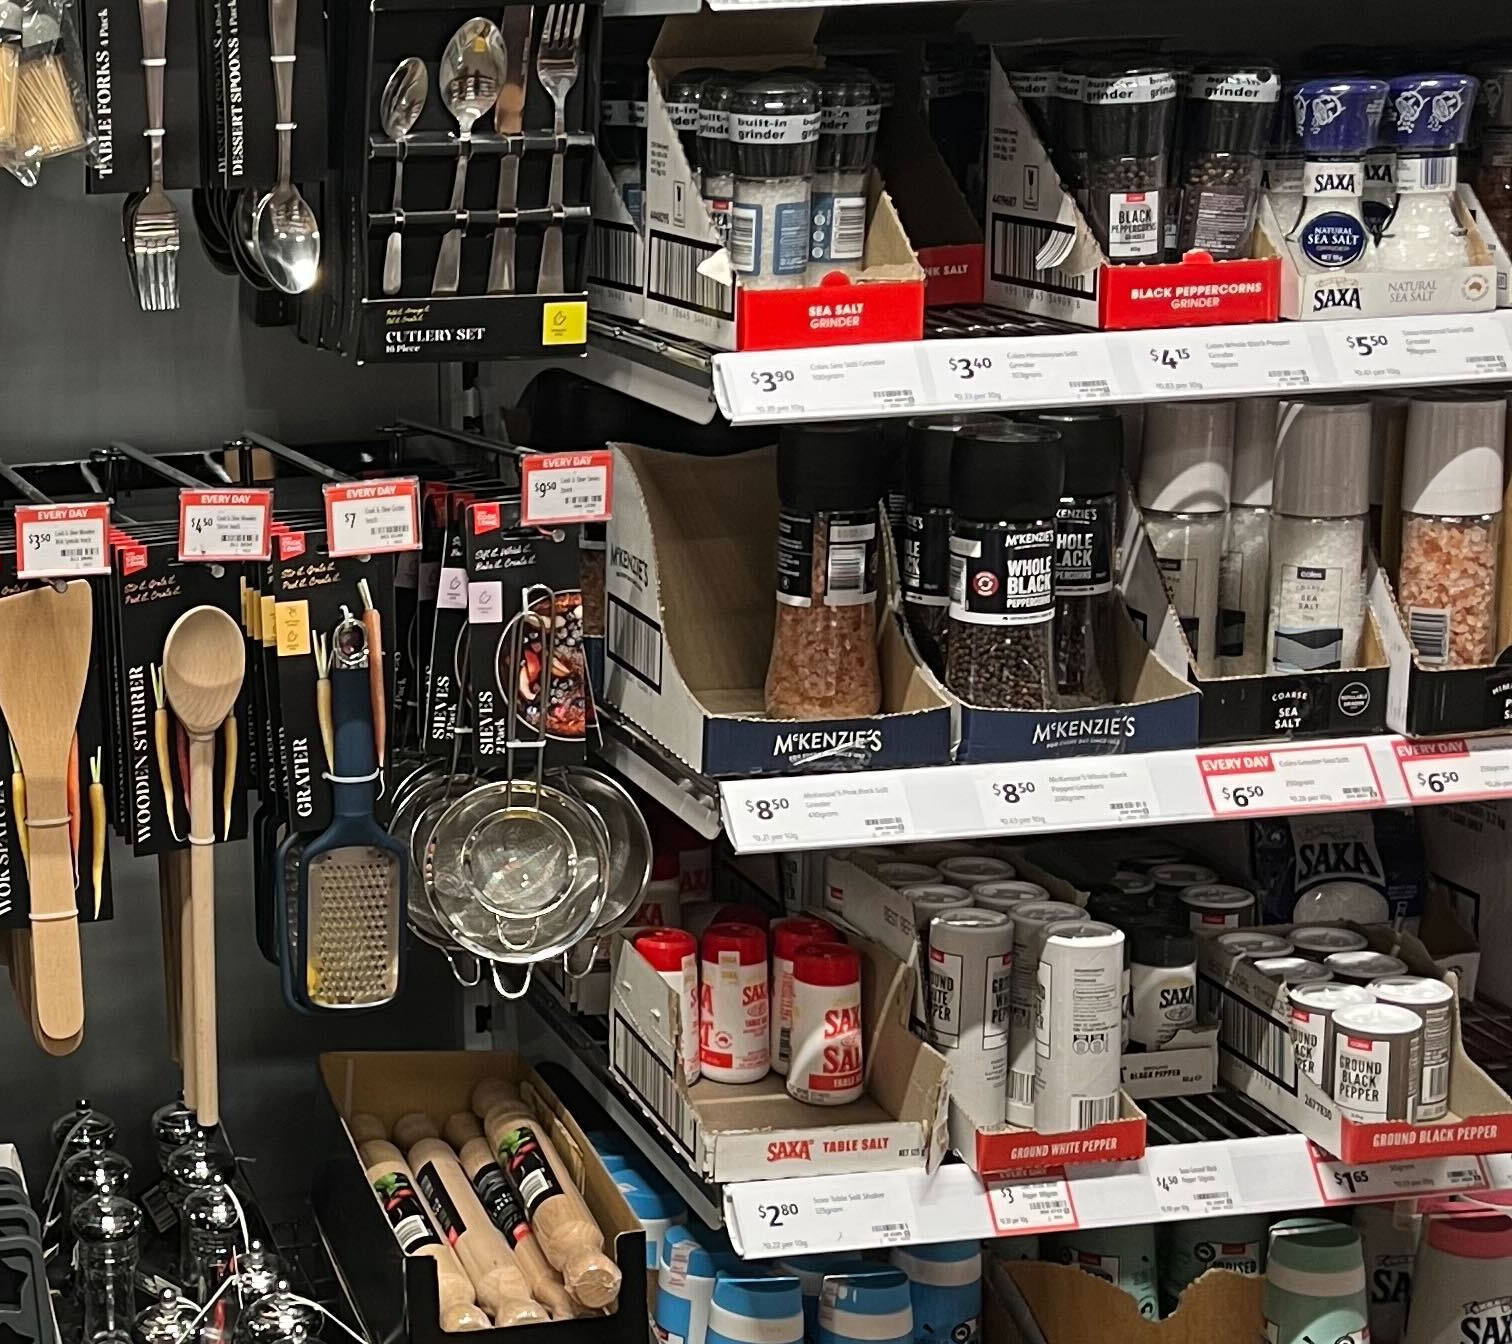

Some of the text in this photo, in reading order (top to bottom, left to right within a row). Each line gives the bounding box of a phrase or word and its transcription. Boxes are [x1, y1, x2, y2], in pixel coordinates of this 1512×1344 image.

[94, 51, 113, 179] TABLE FORKS
[228, 38, 244, 176] DESSERT SPOONS
[738, 128, 785, 141] grinder
[1314, 174, 1355, 193] SAXA
[1307, 233, 1359, 245] SEA SALT
[1314, 226, 1353, 237] NATURAL
[1131, 281, 1262, 300] BLACK PEPPERCORNS
[1312, 287, 1361, 311] SAXA
[808, 303, 864, 316] SEA SALT
[1171, 296, 1220, 310] GRINDER
[810, 315, 860, 329] GRINDER
[385, 327, 486, 344] CUTLERY SET
[344, 512, 357, 529] $7
[1007, 556, 1051, 577] WHOLE
[1007, 572, 1051, 595] BLACK
[1271, 691, 1308, 702] COARSE
[1278, 707, 1298, 718] SEA
[479, 691, 494, 755] SIEVES
[1274, 717, 1302, 730] SALT
[129, 665, 152, 843] WOODEN STIRRER
[1202, 755, 1270, 772] EVERY DAY
[296, 737, 315, 818] GRATER
[1339, 1061, 1382, 1075] GROUND
[1342, 1072, 1378, 1089] BLACK
[1339, 1086, 1380, 1104] PEPPER
[1373, 1125, 1498, 1148] GROUND BLACK PEPPER
[767, 1136, 890, 1164] SAXA TABLE SALT
